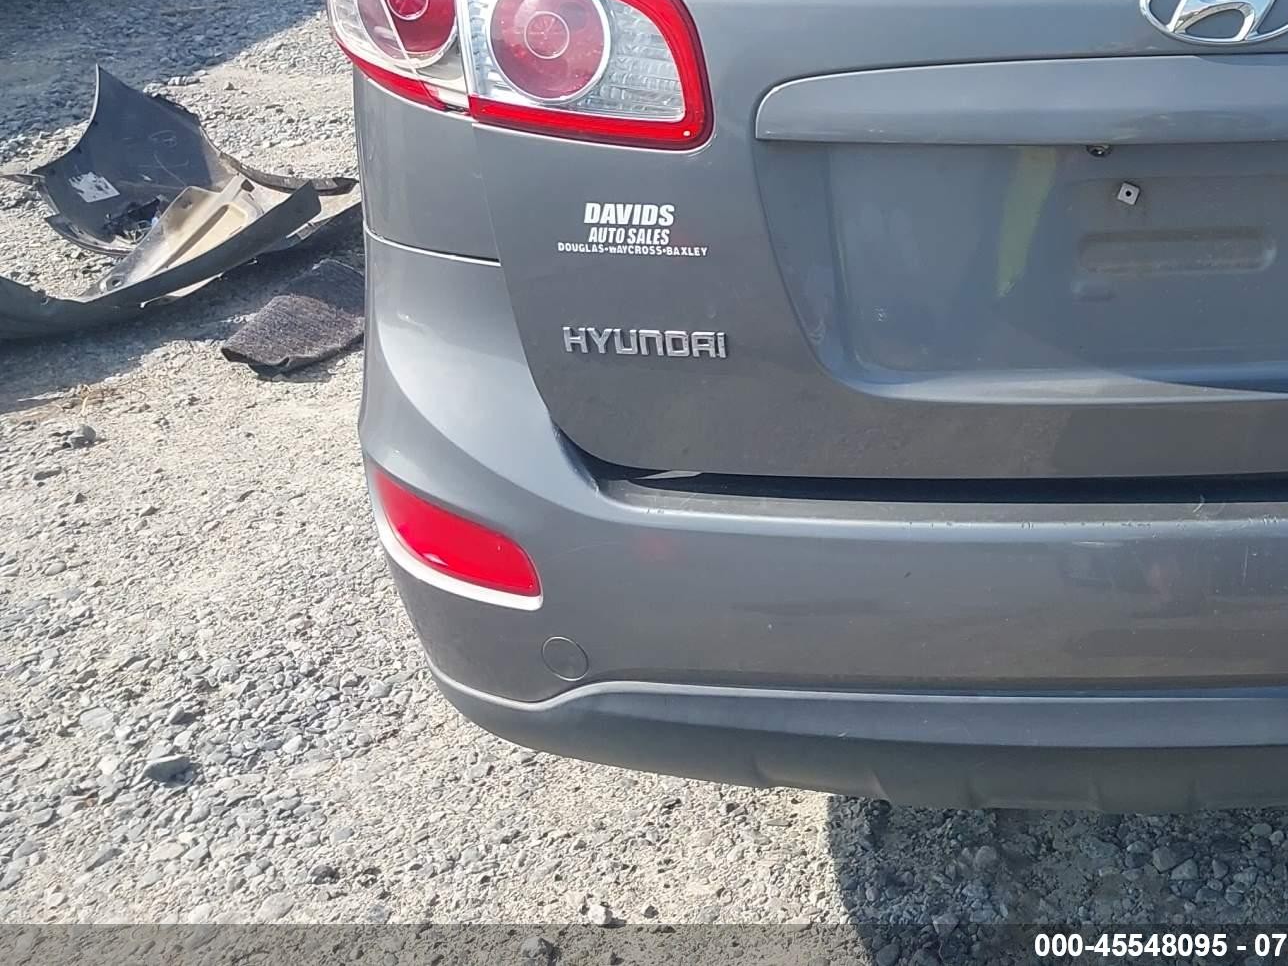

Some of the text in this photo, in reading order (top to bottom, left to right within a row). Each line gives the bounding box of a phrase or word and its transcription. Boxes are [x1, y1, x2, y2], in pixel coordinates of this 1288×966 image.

[584, 202, 675, 226] DAVIDS
[588, 227, 670, 246] AUTO SALES
[562, 326, 727, 359] HYUNDAI
